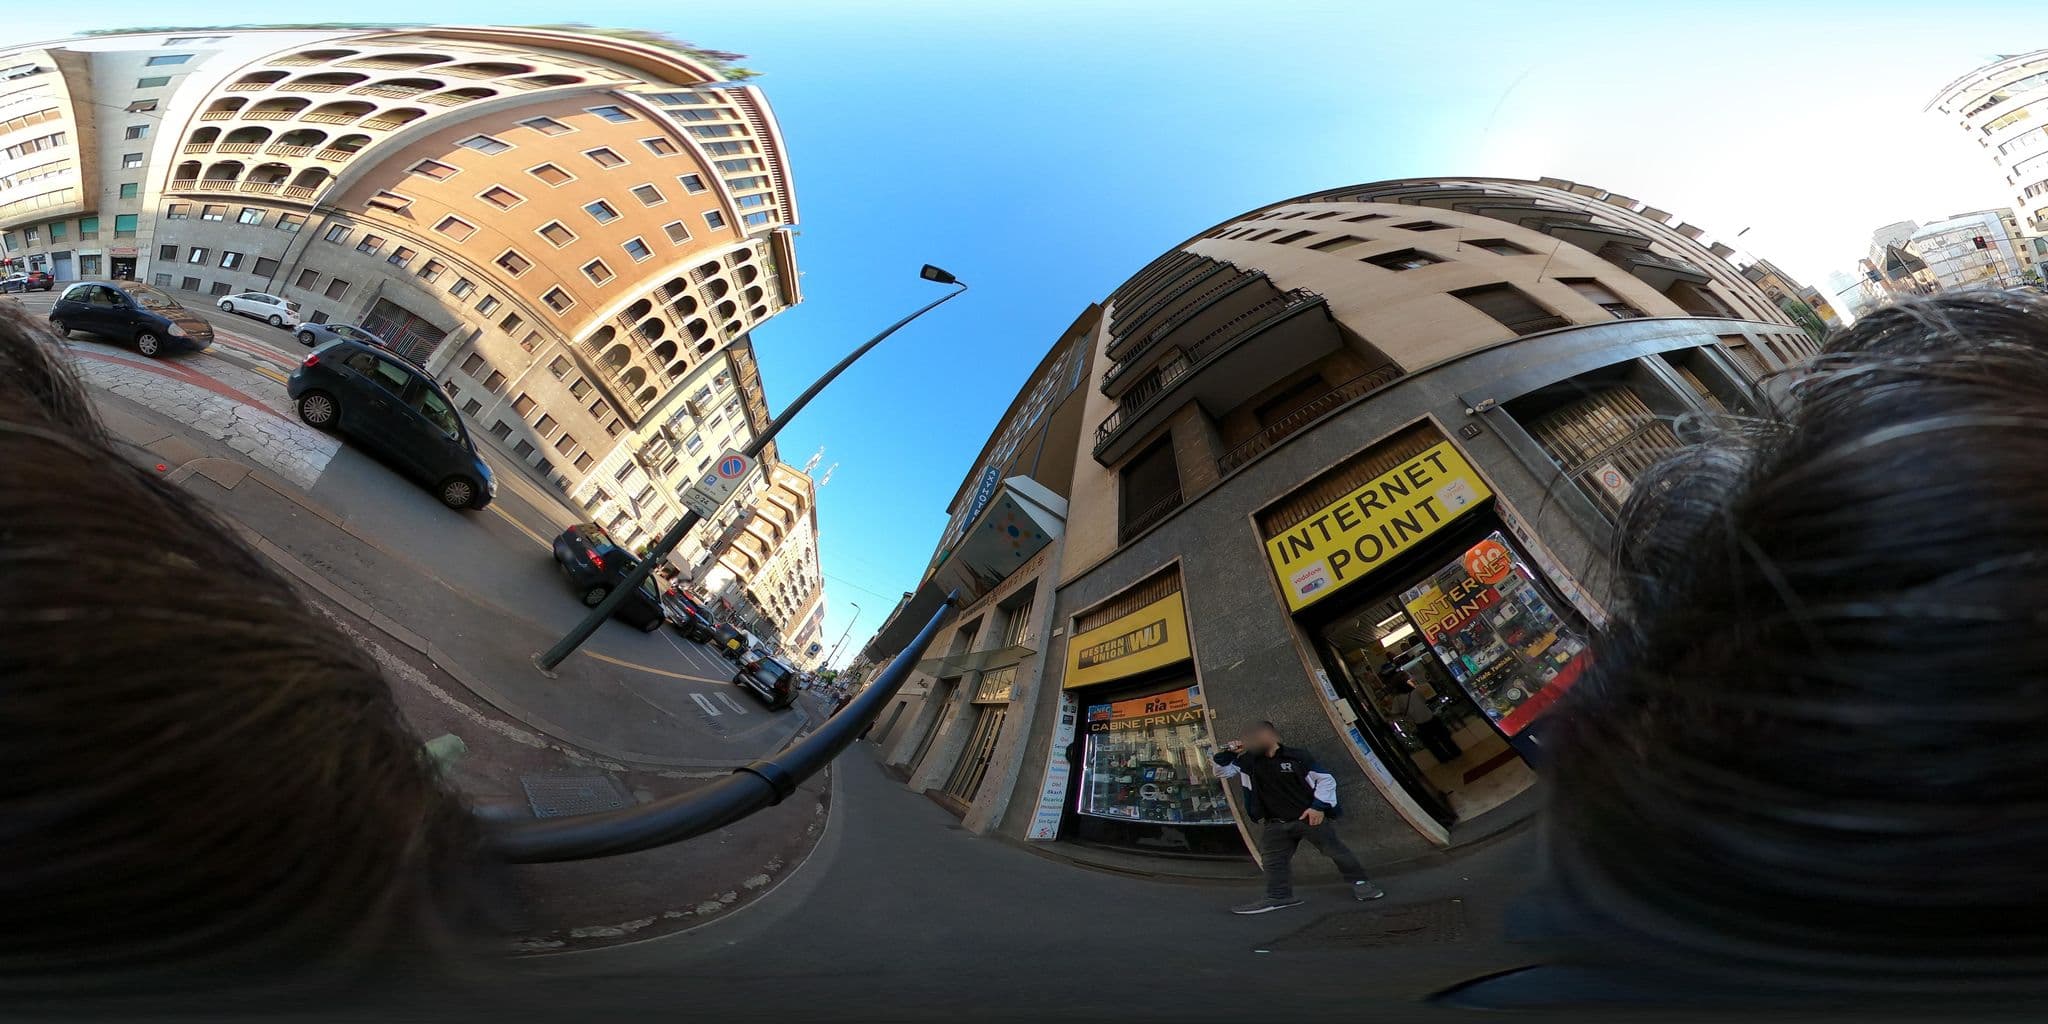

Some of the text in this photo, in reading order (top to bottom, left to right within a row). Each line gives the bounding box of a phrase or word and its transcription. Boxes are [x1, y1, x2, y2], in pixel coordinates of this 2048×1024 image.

[1276, 450, 1451, 565] INTERNET
[1327, 496, 1444, 581] POINT
[1414, 551, 1513, 627] INTERNET
[1425, 590, 1493, 642] POINT
[1080, 637, 1124, 658] WESTERN
[1129, 623, 1161, 651] WU
[1092, 646, 1124, 664] UNION
[1145, 698, 1167, 714] Ria
[1091, 719, 1141, 732] CABINE
